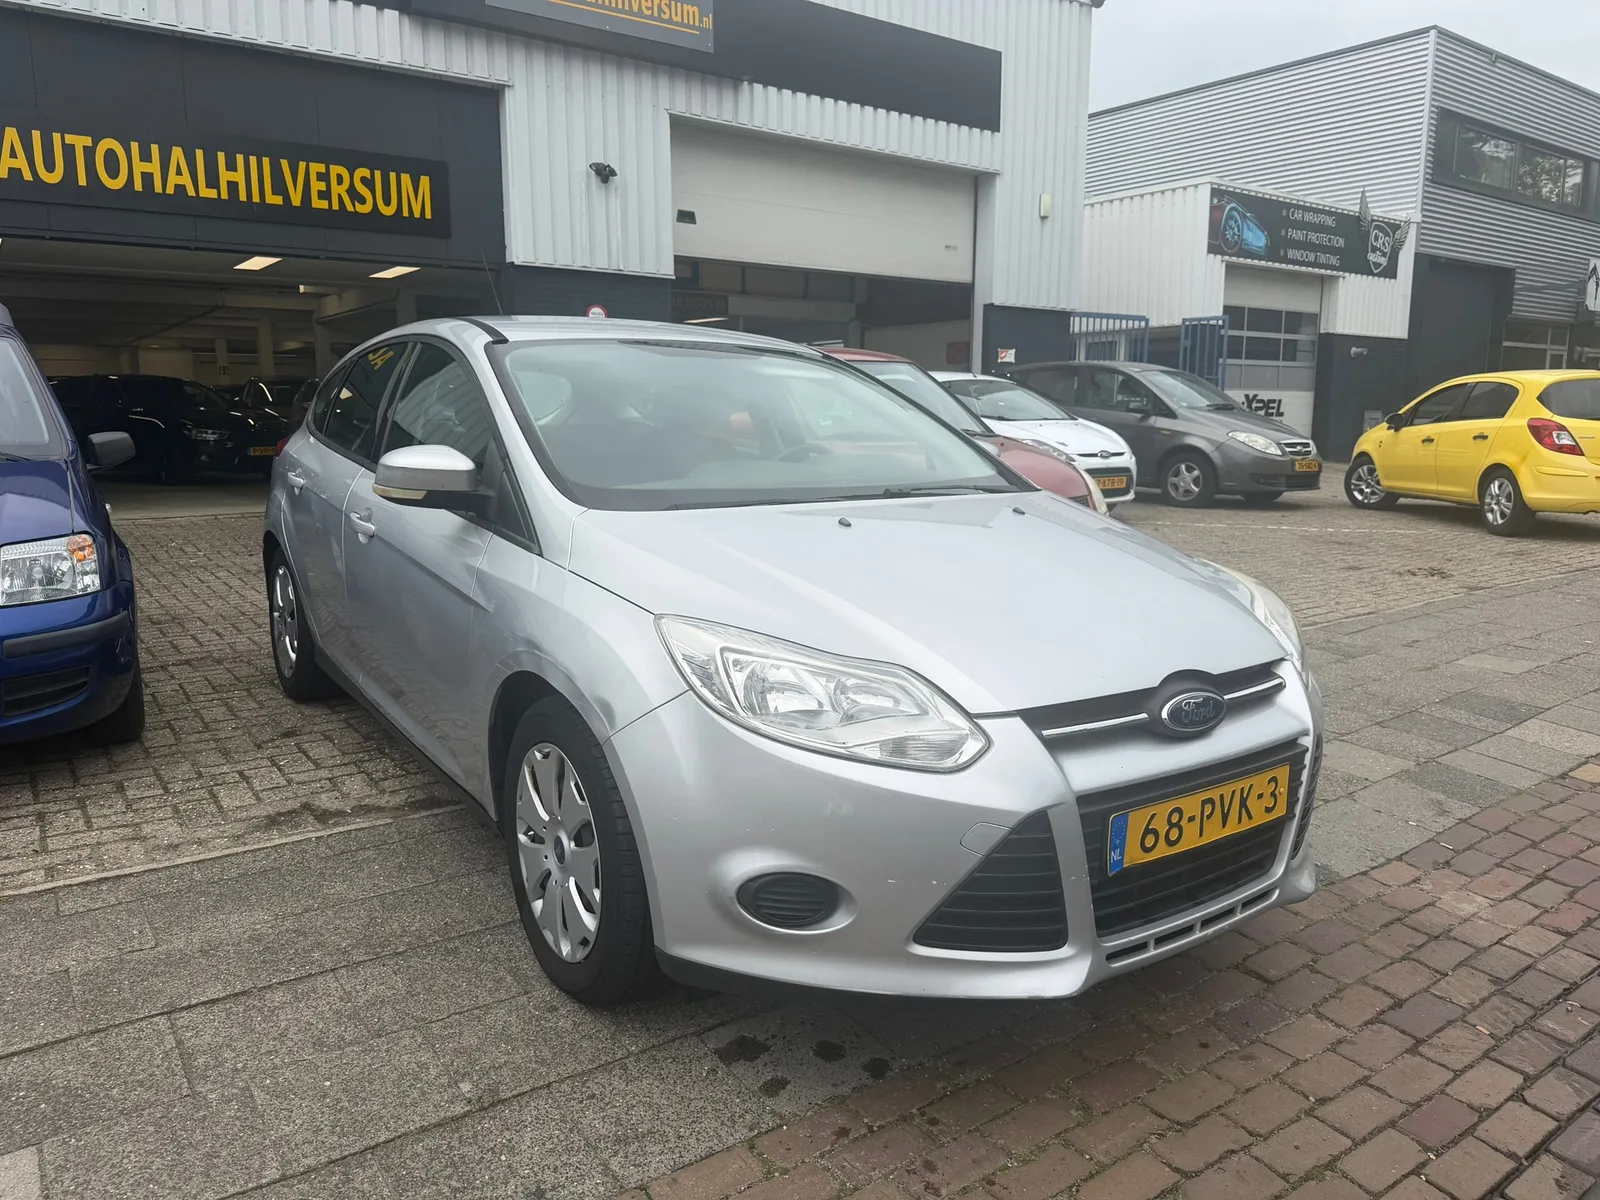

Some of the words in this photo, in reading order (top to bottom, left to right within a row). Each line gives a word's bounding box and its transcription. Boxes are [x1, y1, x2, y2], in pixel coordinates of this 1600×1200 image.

[0, 127, 432, 220] AUTOHALHILVERSUM
[1289, 208, 1303, 221] CAR
[1303, 211, 1336, 227] WRAPPING
[1287, 228, 1307, 242] PAINT
[1307, 231, 1345, 248] PROTECTION
[1372, 230, 1390, 252] CRS
[1287, 248, 1316, 263] WINDOW
[1316, 252, 1340, 266] TINTING
[1182, 697, 1215, 723] Ford
[1140, 775, 1278, 853] 68-PVK-3
[1110, 847, 1122, 863] NL
